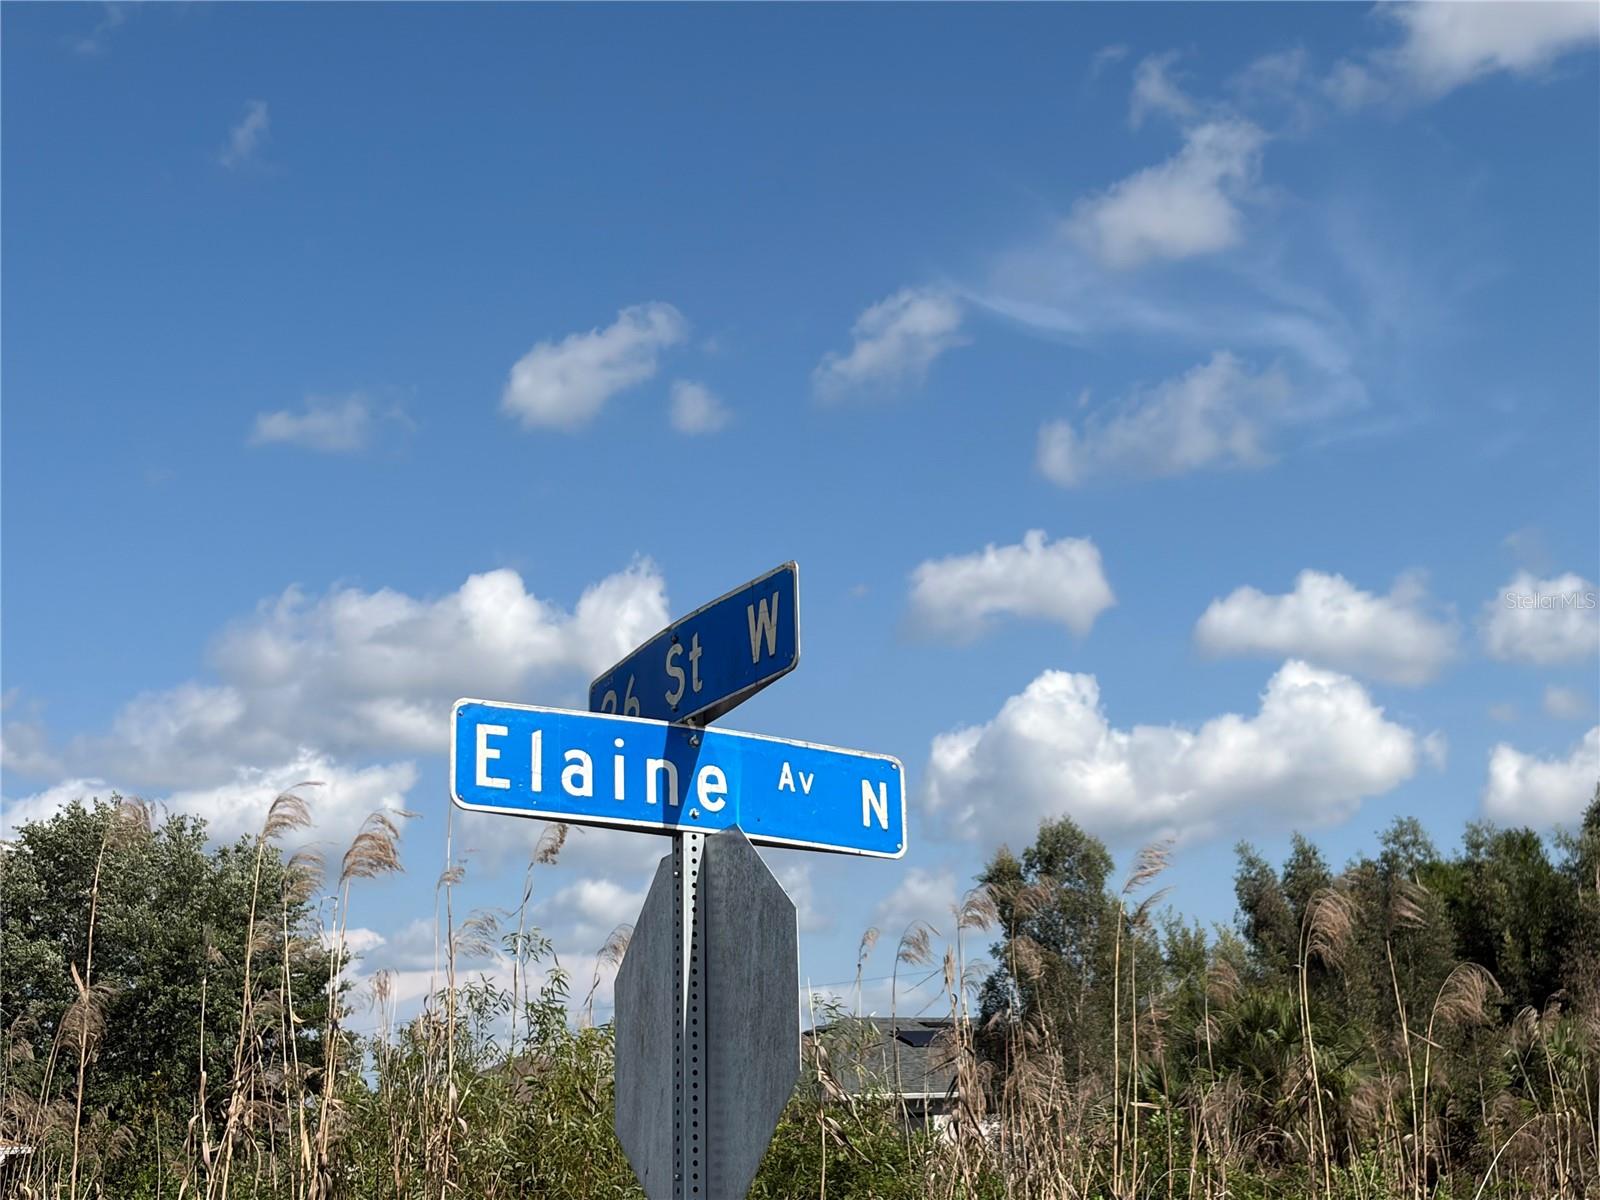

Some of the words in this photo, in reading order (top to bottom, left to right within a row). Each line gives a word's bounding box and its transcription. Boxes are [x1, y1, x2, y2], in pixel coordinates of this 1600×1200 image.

[665, 632, 703, 706] St
[747, 591, 779, 664] W
[475, 723, 729, 812] Elaine
[778, 761, 815, 795] Av
[861, 779, 888, 830] N
